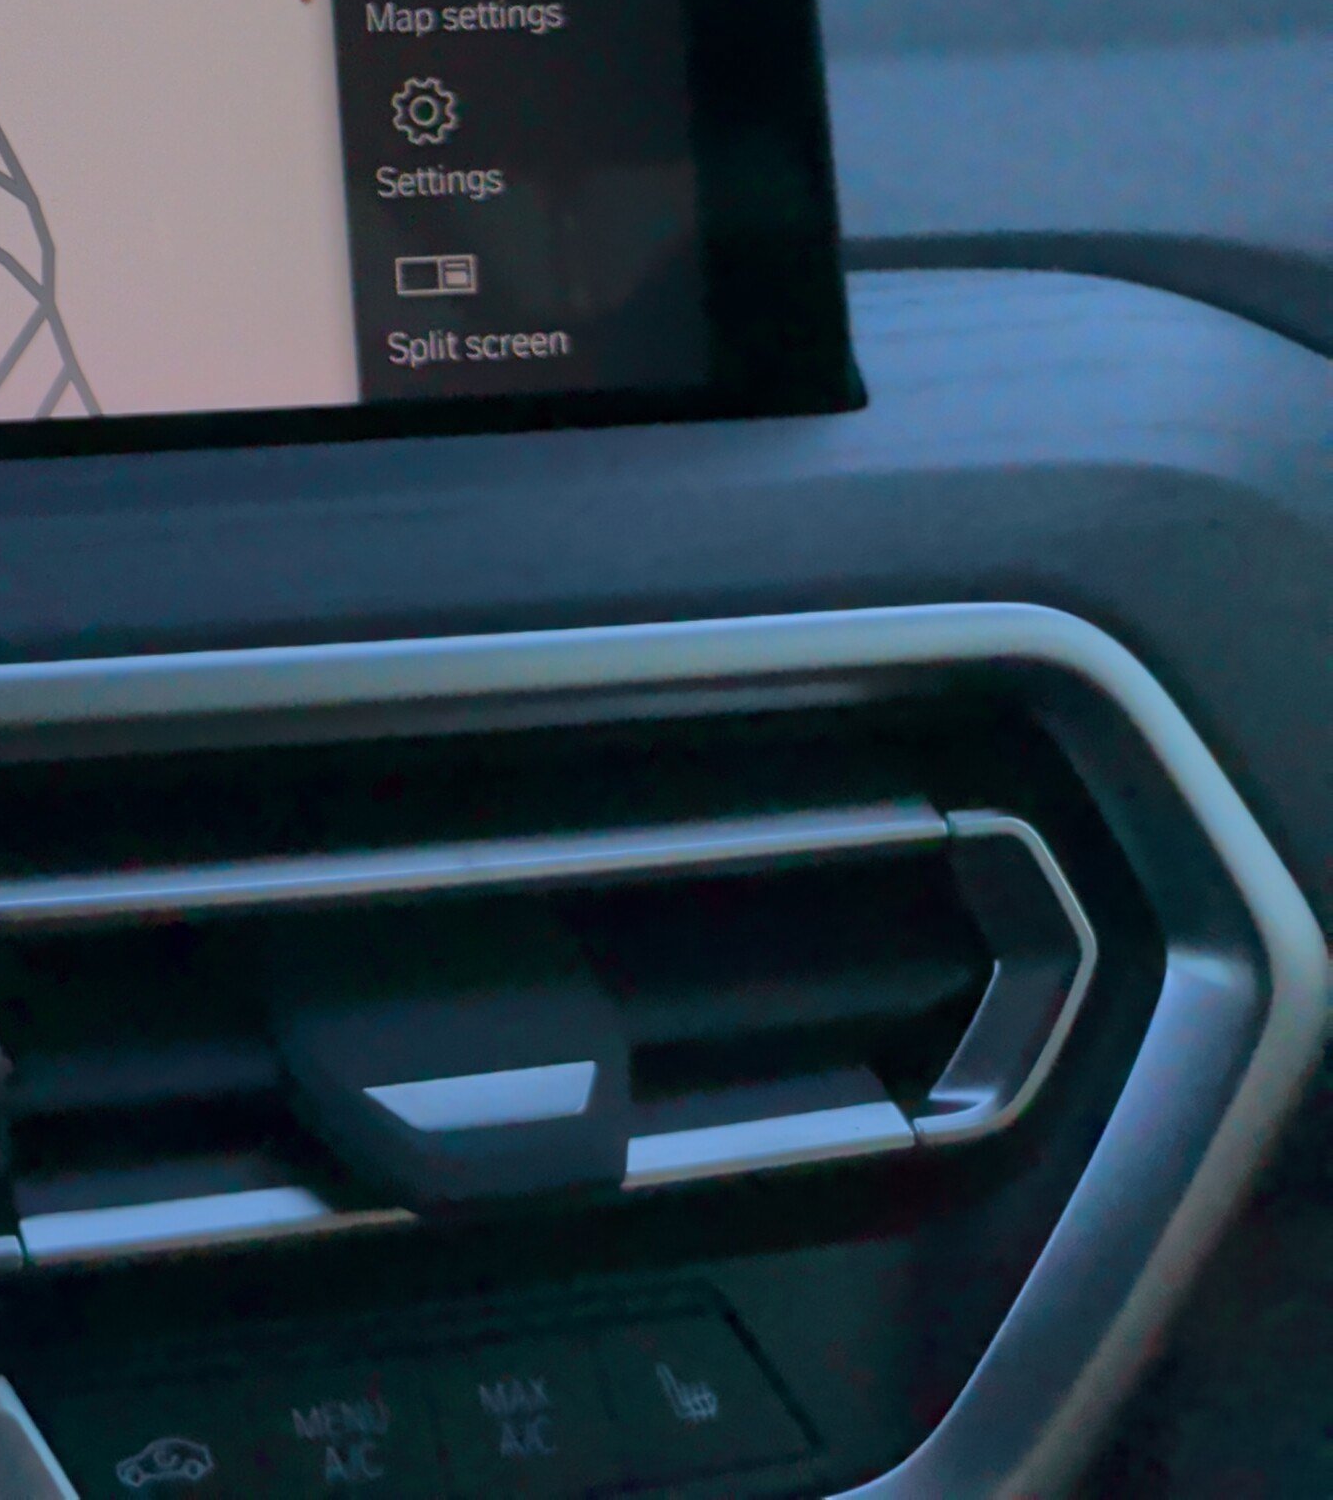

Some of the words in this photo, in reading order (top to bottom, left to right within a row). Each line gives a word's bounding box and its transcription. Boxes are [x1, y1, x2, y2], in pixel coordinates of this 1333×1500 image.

[366, 3, 434, 37] Map
[442, 0, 565, 35] settings
[376, 165, 505, 201] Settings
[387, 330, 458, 368] Split
[465, 331, 571, 360] screen
